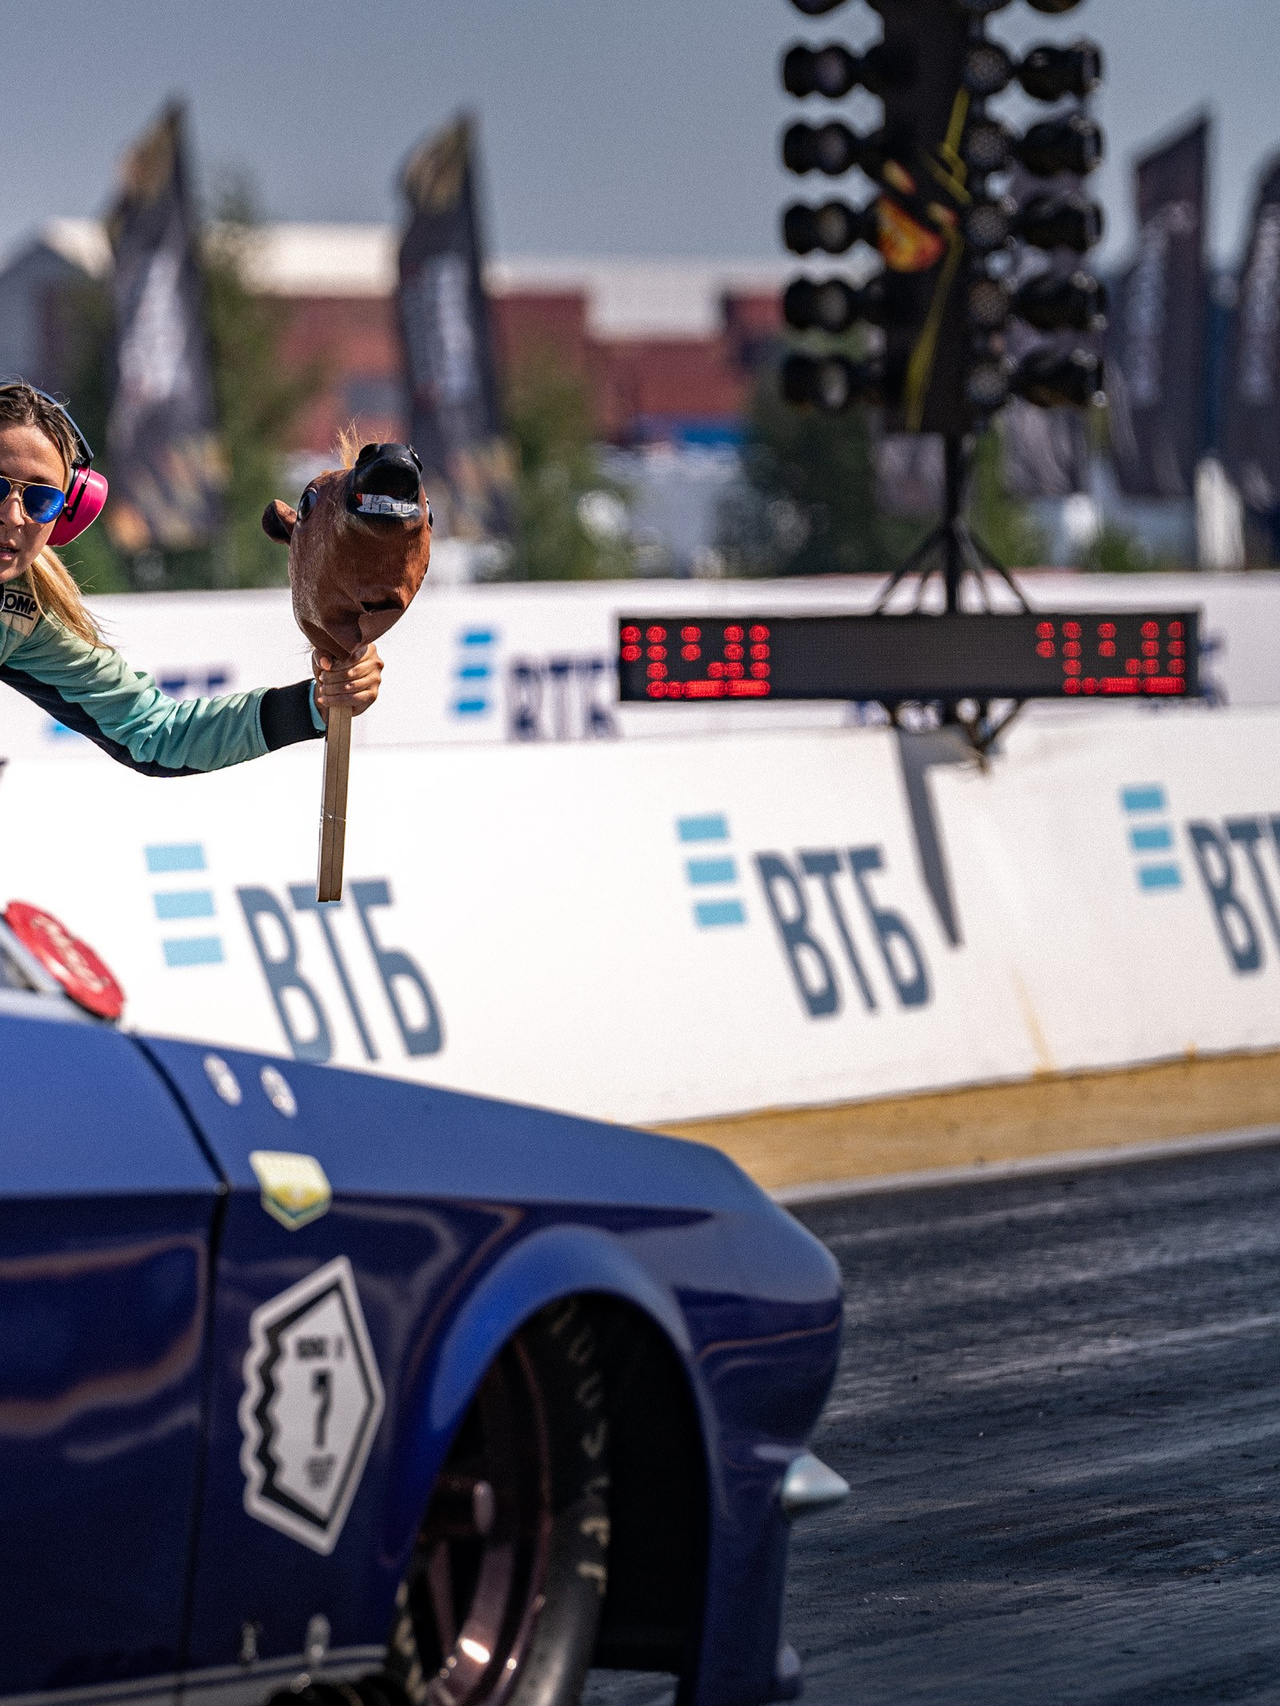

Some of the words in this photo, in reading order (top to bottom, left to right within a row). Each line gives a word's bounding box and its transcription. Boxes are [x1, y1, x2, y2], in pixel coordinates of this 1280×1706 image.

[4, 593, 39, 615] OMP
[235, 877, 444, 1061] ВТБ
[754, 845, 931, 1017] ВТБ
[1188, 814, 1280, 974] ВТ
